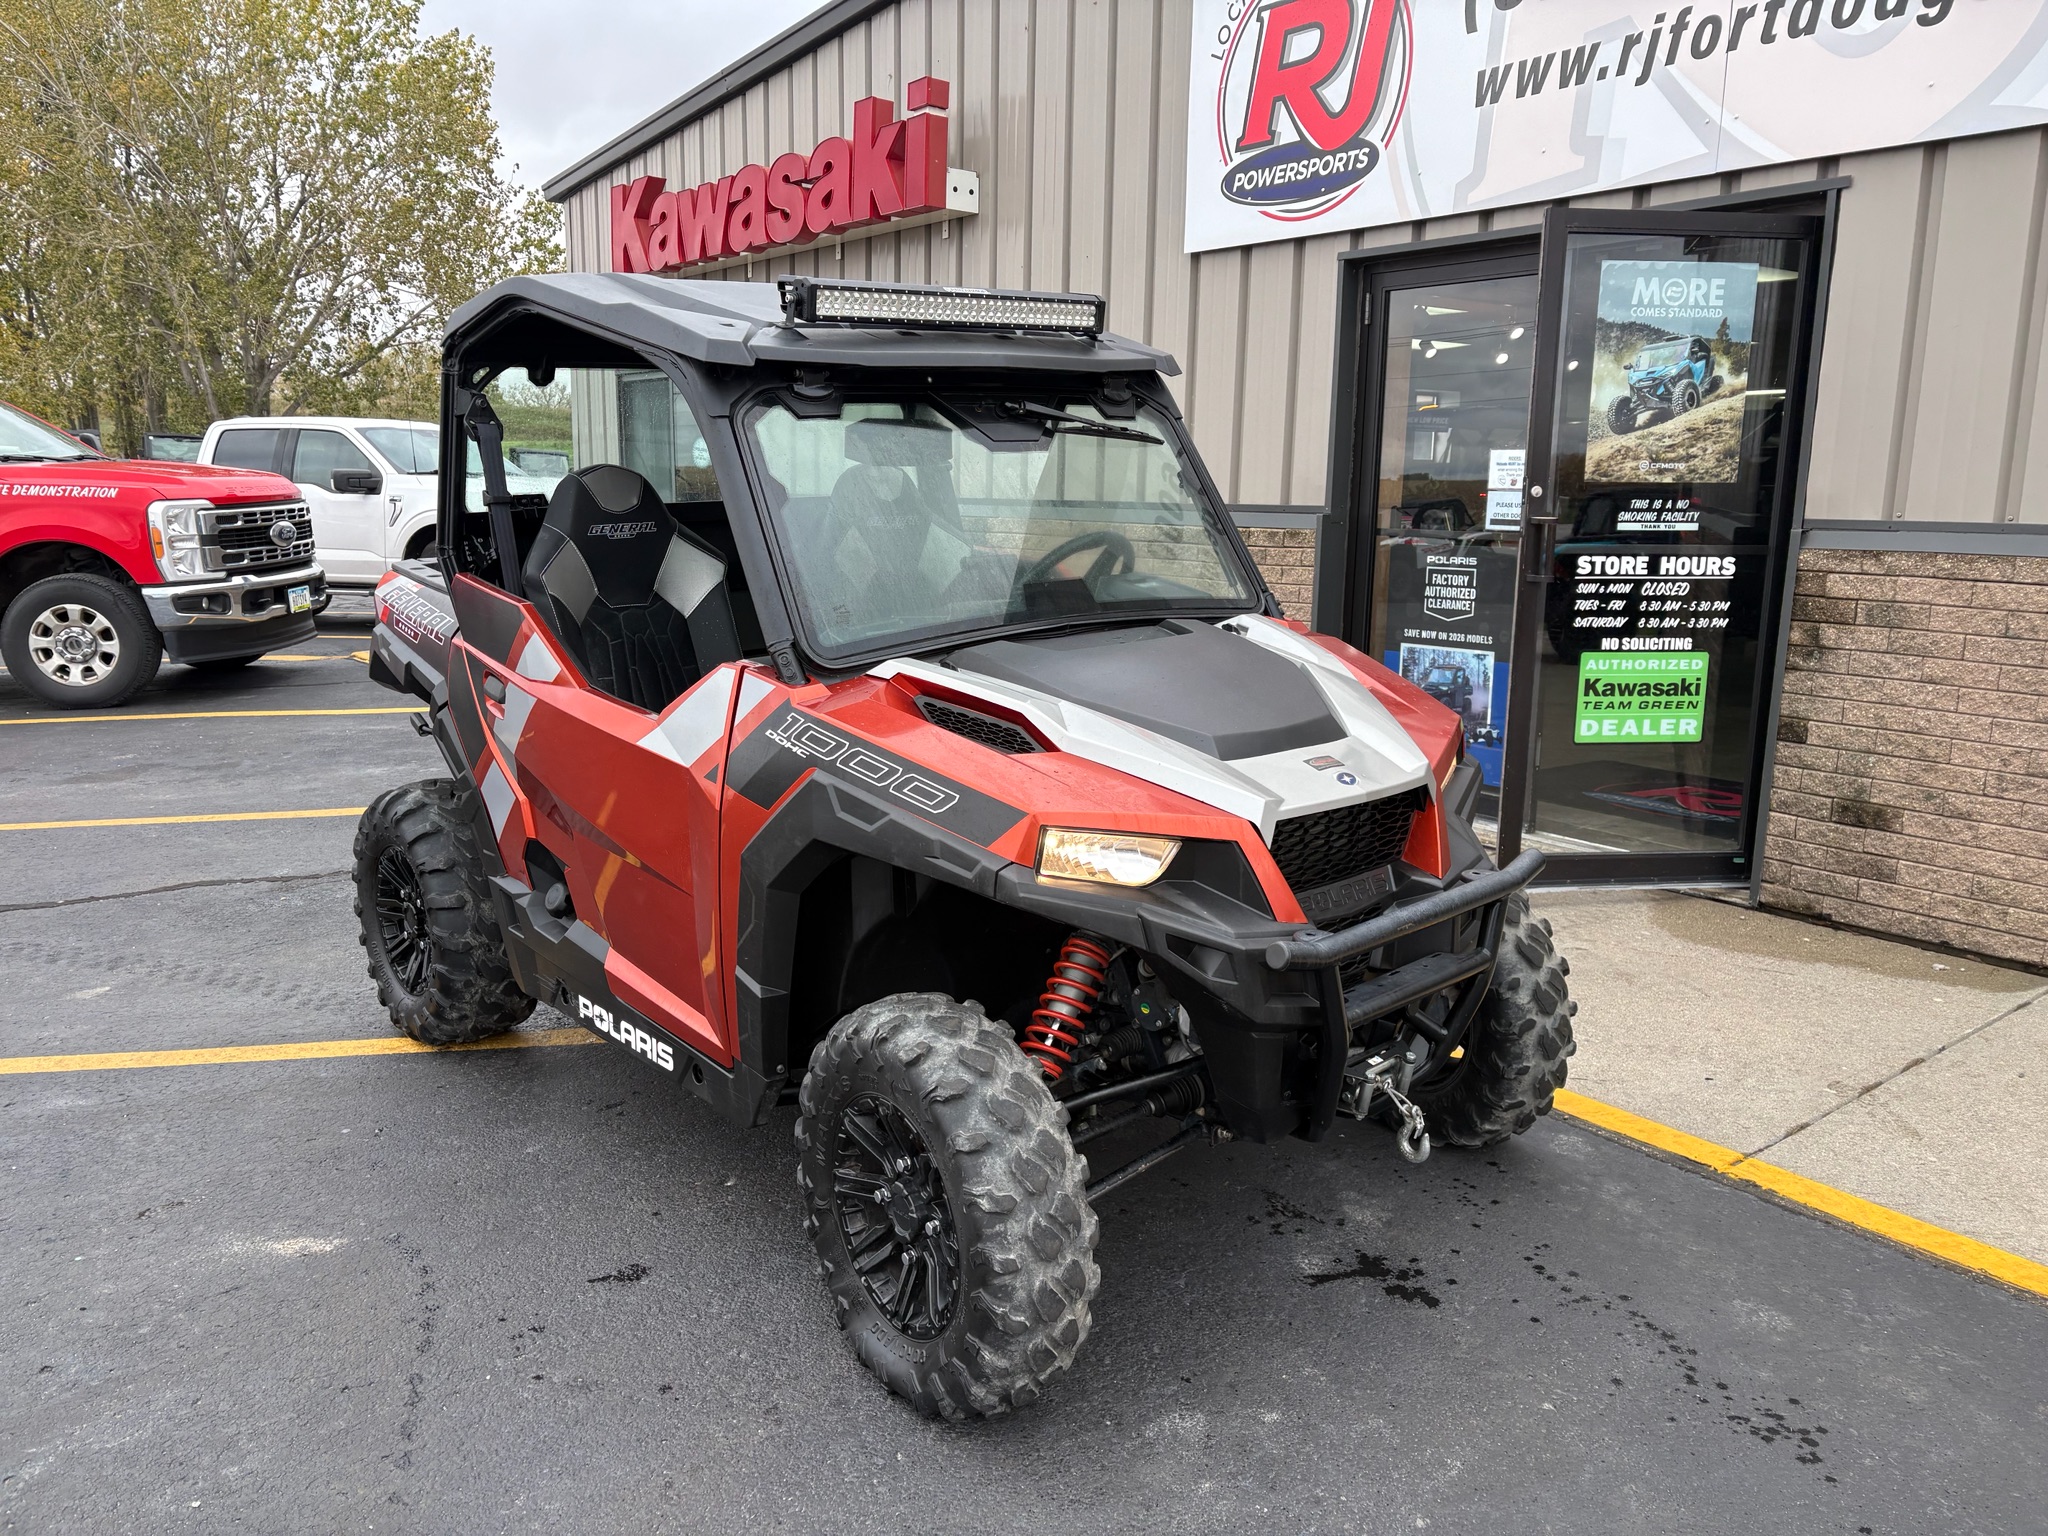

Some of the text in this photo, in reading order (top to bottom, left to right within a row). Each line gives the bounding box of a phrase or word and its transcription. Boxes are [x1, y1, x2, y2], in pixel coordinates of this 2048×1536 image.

[1211, 0, 1246, 61] LOC
[1235, 0, 1399, 153] RJ
[611, 75, 950, 273] Kawasaki
[1233, 147, 1371, 194] POWERSPORTS
[1631, 276, 1727, 307] MORE
[1630, 306, 1723, 318] COMES STANDARD
[12, 484, 119, 498] DEMONSTRATION
[1630, 499, 1690, 510] THIS IS A NO
[1618, 511, 1700, 522] SMOKING FACILITY
[587, 521, 657, 536] GENERAL
[1426, 555, 1478, 566] POLARIS
[1575, 555, 1737, 576] STORE HOURS
[1432, 573, 1470, 587] FACTORY
[1424, 585, 1477, 600] AUTHORIZED
[1576, 582, 1600, 594] SUN
[1606, 582, 1634, 594] MON
[1641, 581, 1691, 597] CLOSED
[1427, 598, 1471, 611] CLEARANCE
[1574, 599, 1600, 611] TUES
[1607, 600, 1627, 611] FRI
[1661, 600, 1682, 612] AM
[1711, 600, 1731, 612] PM
[380, 585, 455, 646] GENERAL
[1573, 616, 1629, 628] SATURDAY
[1660, 617, 1680, 629] AM
[1709, 617, 1730, 629] PM
[1403, 628, 1493, 645] SAVE NOW ON 2026 MODELS
[1601, 637, 1693, 651] NO SOLICITING
[1585, 659, 1703, 671] AUTHORIZED
[1583, 677, 1702, 697] Kawasaki
[1582, 700, 1700, 710] TEAM GREEN
[1580, 718, 1699, 737] DEALER
[764, 729, 811, 759] DOHC
[776, 712, 960, 814] 1000
[1300, 872, 1390, 913] POLARIS
[578, 994, 674, 1072] POLARIS
